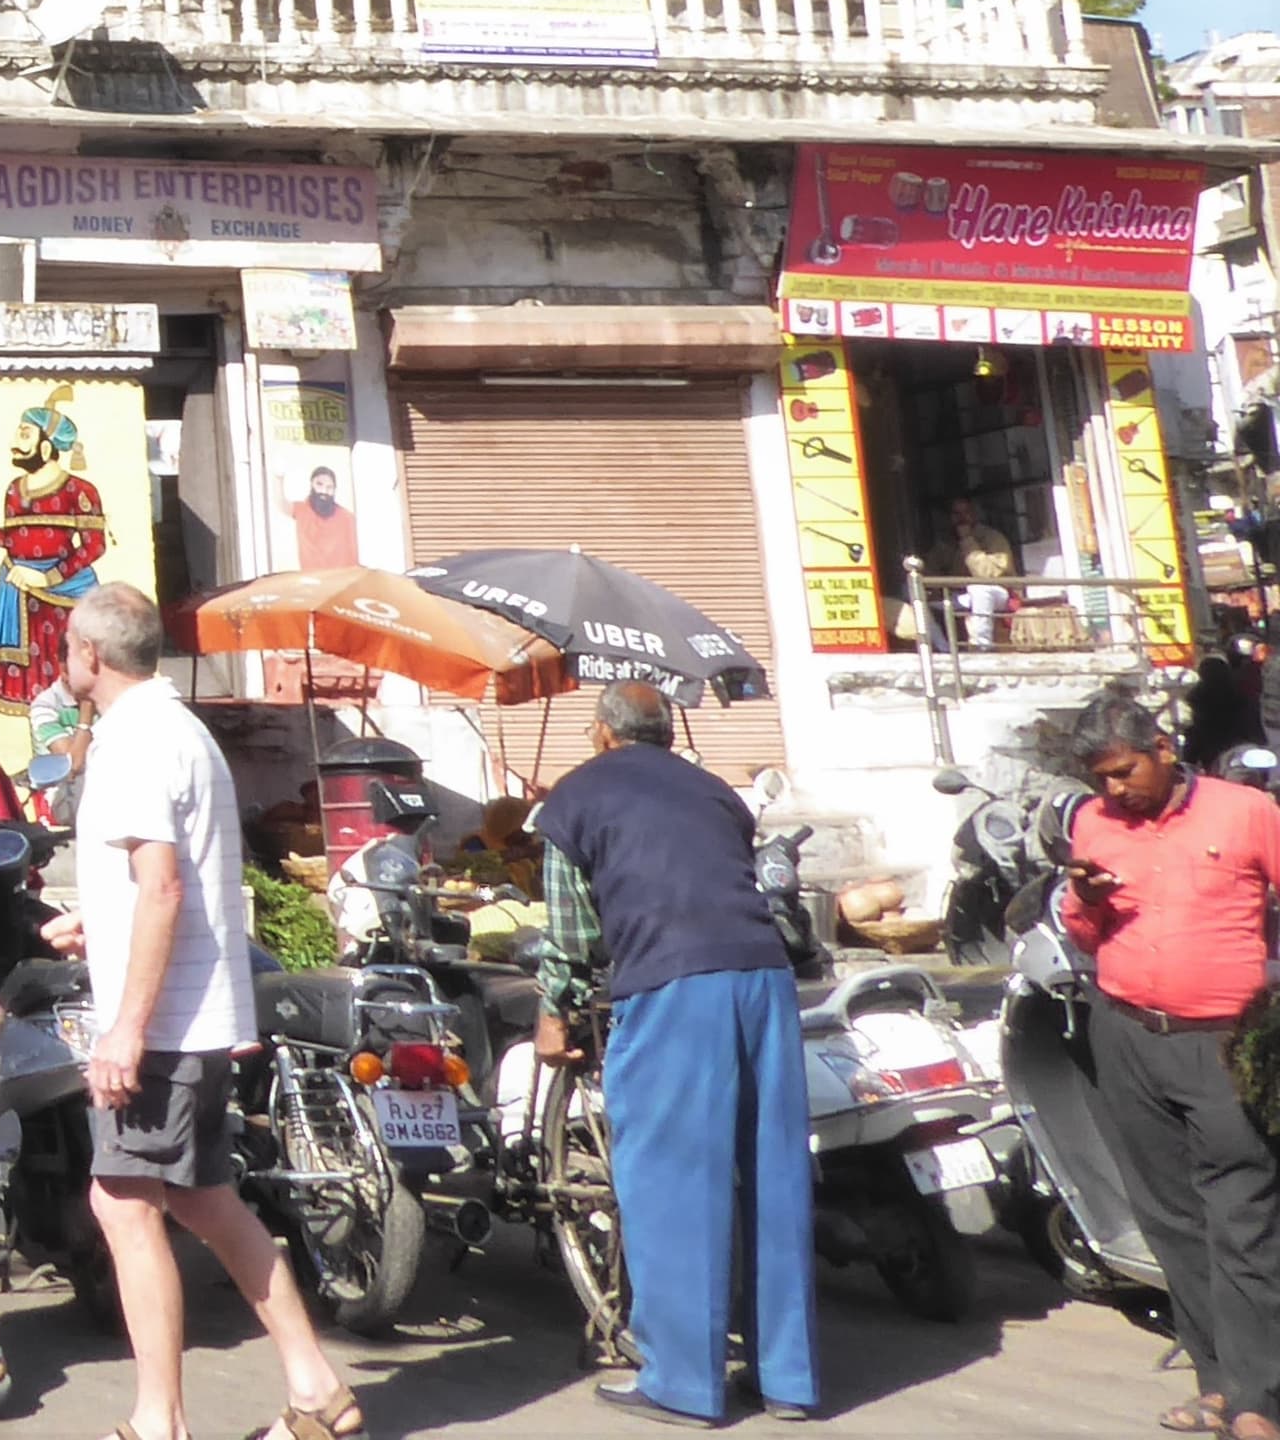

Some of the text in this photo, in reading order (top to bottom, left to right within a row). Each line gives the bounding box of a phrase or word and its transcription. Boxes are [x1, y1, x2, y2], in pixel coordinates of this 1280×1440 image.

[132, 168, 366, 226] ENTERPRISES
[72, 215, 302, 239] MONEY EXCHANGE
[948, 182, 1194, 249] Hare Krishna
[1099, 316, 1184, 335] LESSON
[1099, 332, 1184, 350] FACILITY
[332, 604, 434, 643] vodafone
[583, 620, 667, 658] UBER
[577, 654, 615, 681] Ride
[616, 662, 633, 680] at
